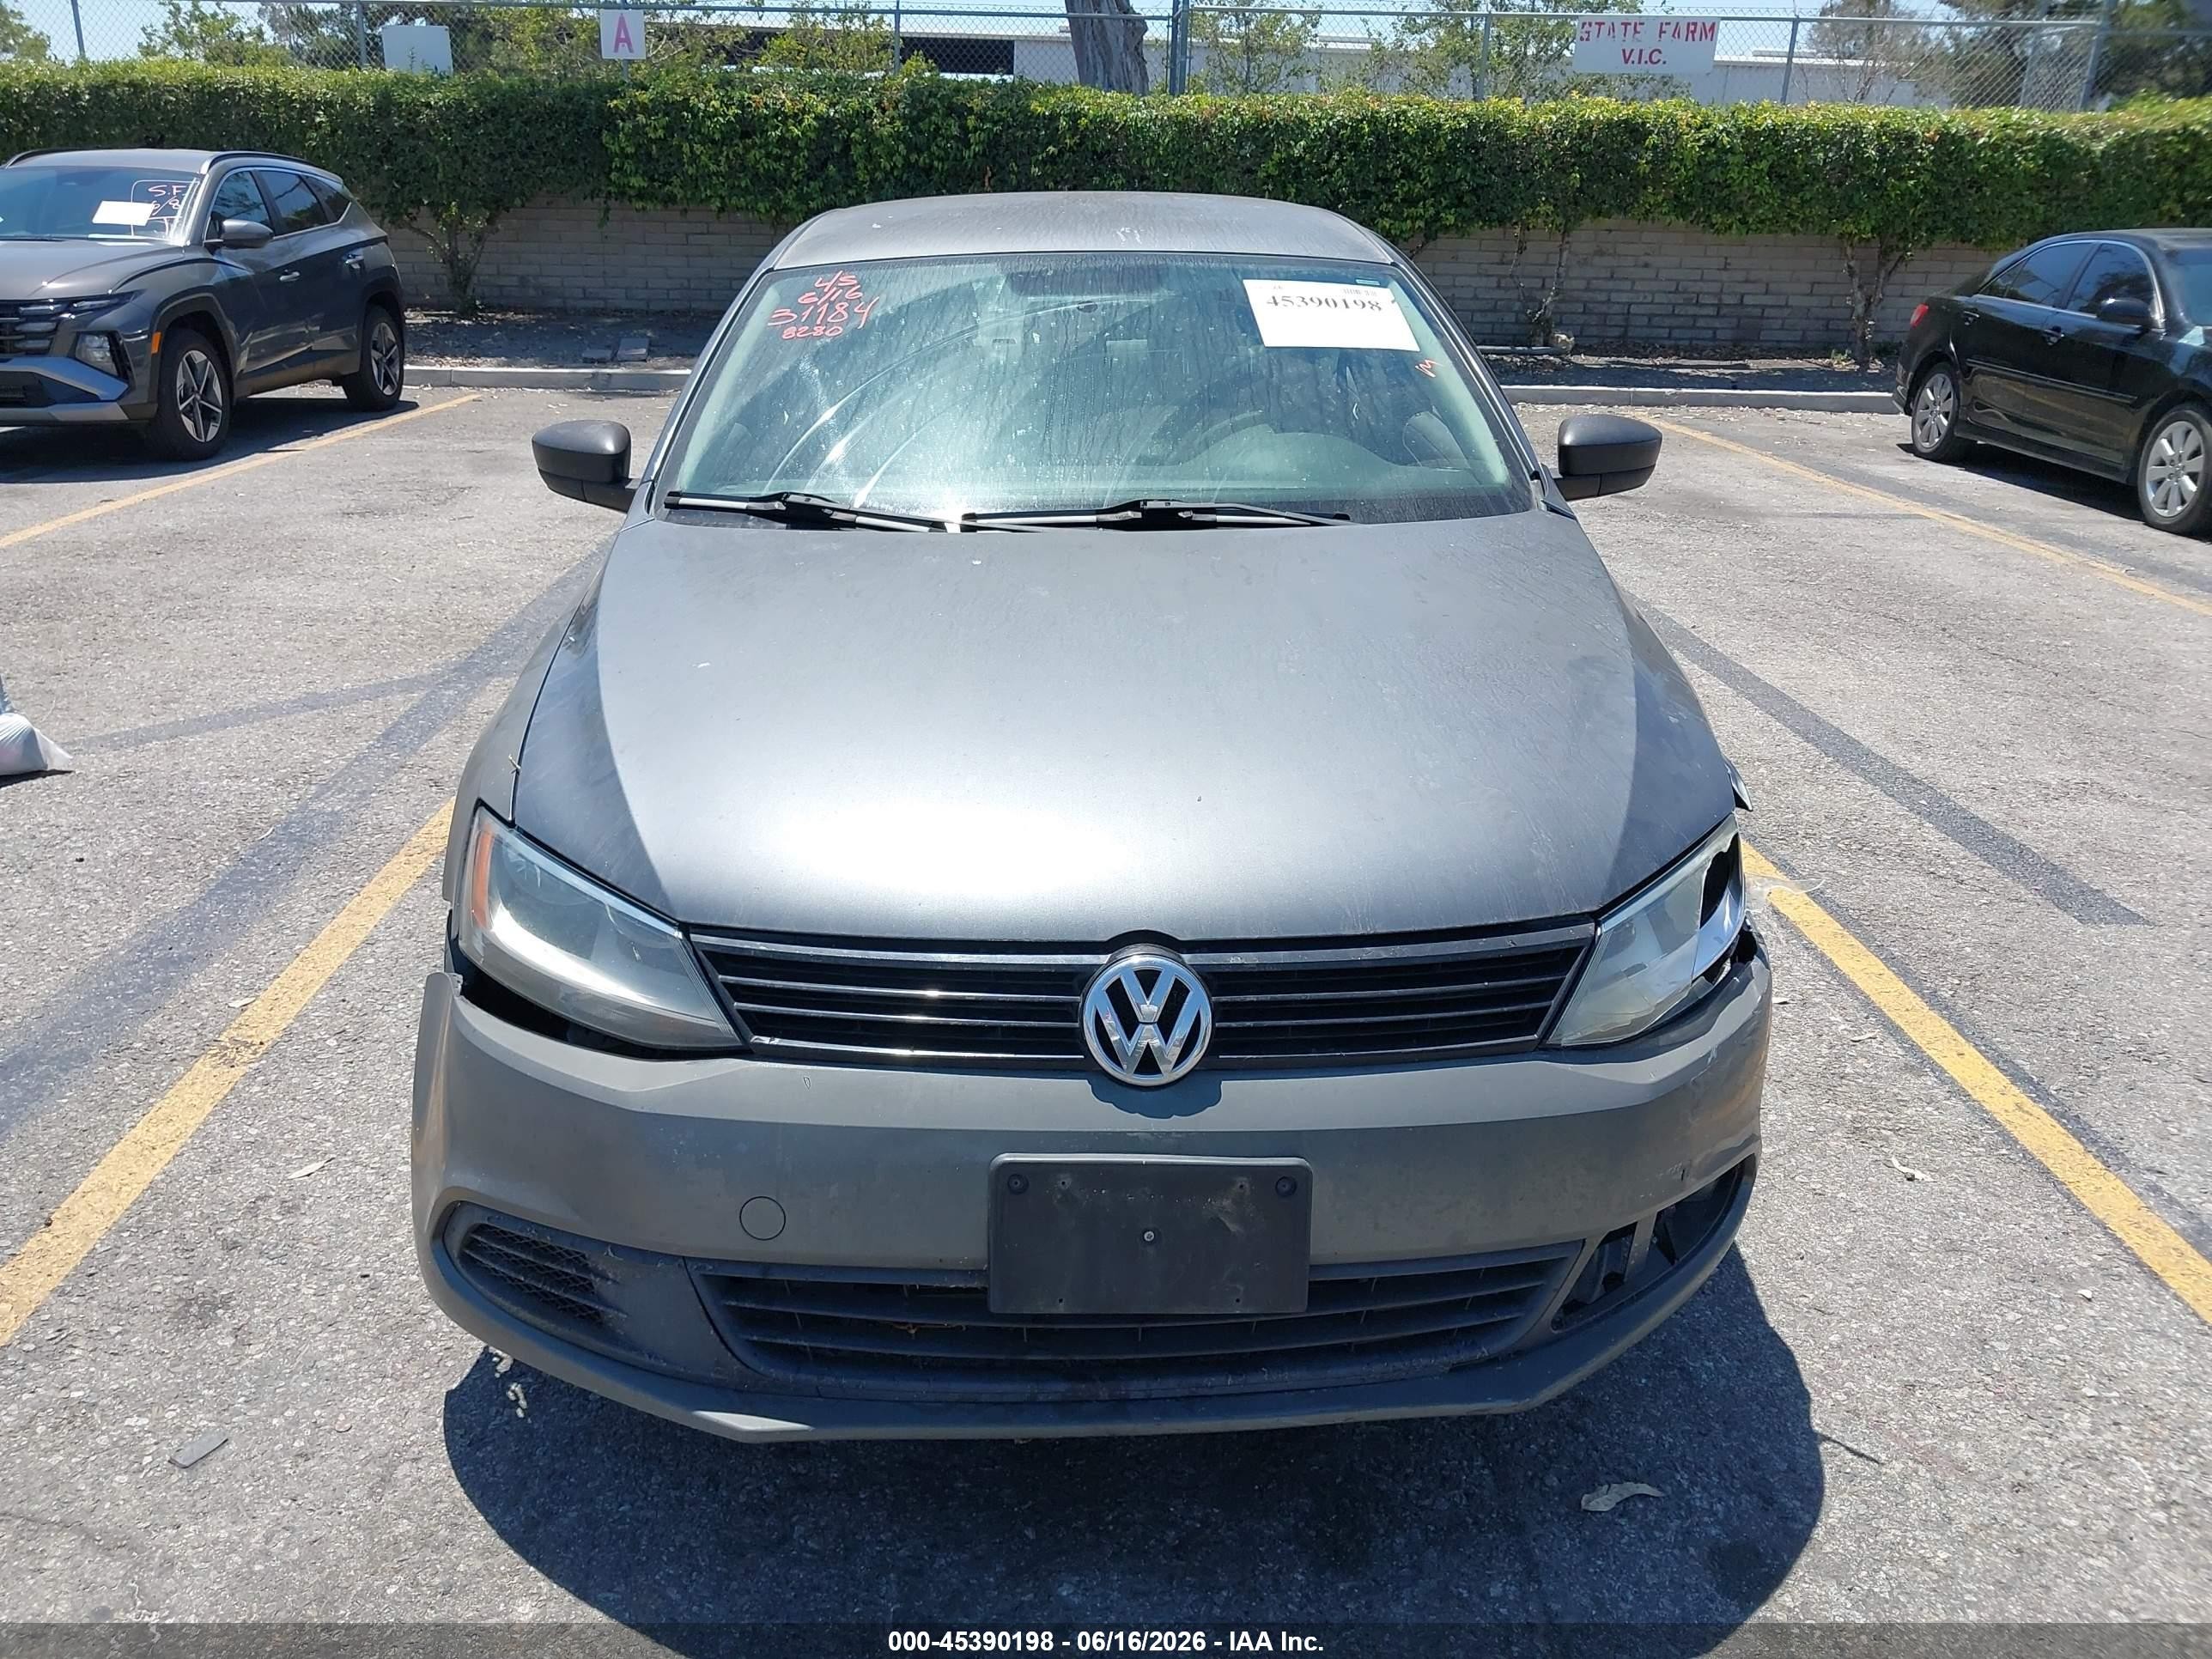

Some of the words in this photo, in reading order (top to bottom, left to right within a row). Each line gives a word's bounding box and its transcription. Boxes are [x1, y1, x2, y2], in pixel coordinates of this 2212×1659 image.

[613, 12, 635, 53] A
[1579, 21, 1645, 42] STATE
[1657, 21, 1717, 42] FARM
[1621, 48, 1667, 65] V.I.C.
[1267, 295, 1383, 312] 45390198
[1091, 963, 1206, 1079] VW
